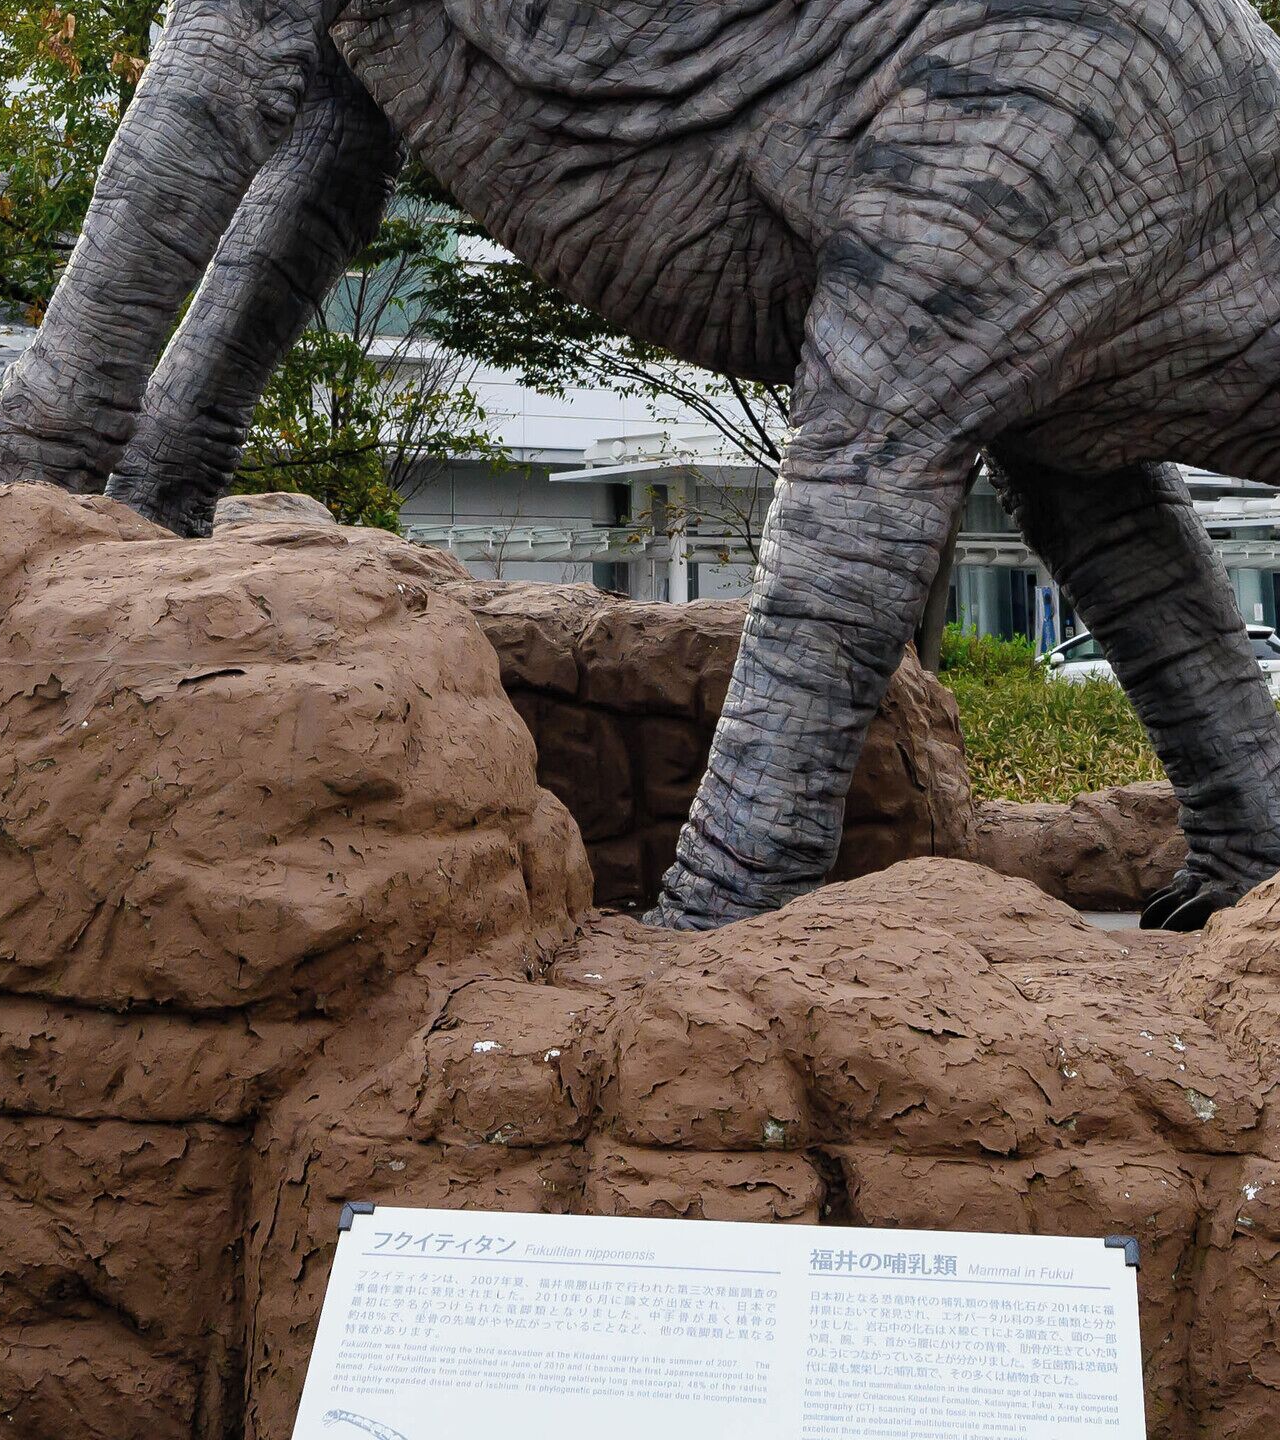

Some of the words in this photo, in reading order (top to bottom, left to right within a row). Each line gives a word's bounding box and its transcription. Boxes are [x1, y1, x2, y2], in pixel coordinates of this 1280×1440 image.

[373, 1231, 517, 1255] フクイティタン
[523, 1244, 582, 1257] Fukuititan
[584, 1247, 656, 1261] nipponensis
[809, 1248, 958, 1276] 福井の哺乳類
[968, 1264, 1020, 1278] Mammal
[1024, 1265, 1036, 1278] in
[1040, 1267, 1074, 1280] Fukui
[338, 1350, 382, 1362] description
[385, 1353, 393, 1361] of
[396, 1353, 436, 1363] Fukuititan
[457, 1357, 497, 1369] published
[500, 1359, 508, 1367] in
[511, 1359, 530, 1368] June
[533, 1361, 541, 1369] of
[544, 1361, 564, 1370] 2010
[567, 1362, 582, 1371] and
[593, 1364, 625, 1373] became
[628, 1366, 641, 1374] the
[644, 1366, 661, 1375] first
[745, 1372, 754, 1380] to
[756, 1372, 767, 1381] be
[340, 1339, 382, 1349] Fukuititan
[403, 1342, 427, 1351] found
[429, 1344, 456, 1355] during
[458, 1345, 472, 1354] the
[474, 1346, 494, 1355] third
[497, 1347, 542, 1358] excavation
[545, 1350, 554, 1358] at
[556, 1350, 570, 1359] the
[572, 1351, 608, 1361] Kitadani
[610, 1355, 638, 1365] quarry
[641, 1355, 649, 1363] in
[652, 1355, 665, 1364] the
[669, 1358, 702, 1366] summer
[705, 1358, 714, 1367] of
[755, 1361, 770, 1370] The
[330, 1384, 338, 1393] of
[340, 1385, 353, 1393] the
[332, 1372, 348, 1381] and
[351, 1373, 382, 1385] slightly
[385, 1375, 426, 1387] expanded
[429, 1378, 454, 1387] distal
[455, 1379, 471, 1388] end
[474, 1380, 482, 1388] of
[524, 1383, 537, 1391] Its
[536, 1384, 590, 1396] phylogenetic
[592, 1387, 624, 1398] position
[626, 1389, 634, 1397] is
[636, 1389, 649, 1398] not
[652, 1390, 672, 1399] clear
[674, 1391, 690, 1400] due
[692, 1392, 700, 1400] to
[702, 1393, 766, 1406] incompleteness
[367, 1363, 408, 1373] Fukuititan
[410, 1366, 436, 1375] differs
[438, 1367, 456, 1376] from
[459, 1368, 480, 1377] other
[483, 1369, 525, 1382] sauropods
[528, 1372, 535, 1380] in
[538, 1372, 565, 1384] having
[568, 1374, 606, 1386] relatively
[608, 1376, 628, 1387] long
[709, 1382, 718, 1390] of
[721, 1382, 735, 1391] the
[739, 1383, 768, 1393] radius
[804, 1377, 812, 1385] In
[837, 1379, 849, 1387] the
[852, 1379, 866, 1388] first
[868, 1380, 911, 1391] mammalian
[913, 1383, 945, 1392] skeleton
[947, 1385, 954, 1393] in
[956, 1385, 969, 1394] the
[971, 1386, 1004, 1395] dinosaur
[1006, 1389, 1020, 1398] age
[1022, 1389, 1030, 1397] of
[1032, 1389, 1056, 1400] Japan
[1075, 1391, 1118, 1401] discovered
[803, 1400, 852, 1413] tomography
[855, 1403, 874, 1414] (CT)
[878, 1405, 916, 1417] scanning
[919, 1407, 927, 1415] of
[930, 1408, 943, 1416] the
[968, 1410, 976, 1418] in
[978, 1410, 994, 1419] rock
[997, 1411, 1011, 1420] has
[1013, 1412, 1048, 1422] revealed
[1056, 1415, 1082, 1426] partial
[1104, 1417, 1119, 1426] and
[804, 1388, 821, 1397] from
[823, 1389, 835, 1398] the
[837, 1390, 860, 1399] Lower
[862, 1392, 905, 1402] Cretaceous
[907, 1394, 939, 1404] Kitadani
[1058, 1403, 1078, 1414] X-ray
[1080, 1404, 1118, 1416] computed
[845, 1415, 853, 1423] of
[982, 1422, 1016, 1431] mammal
[1018, 1424, 1026, 1432] in
